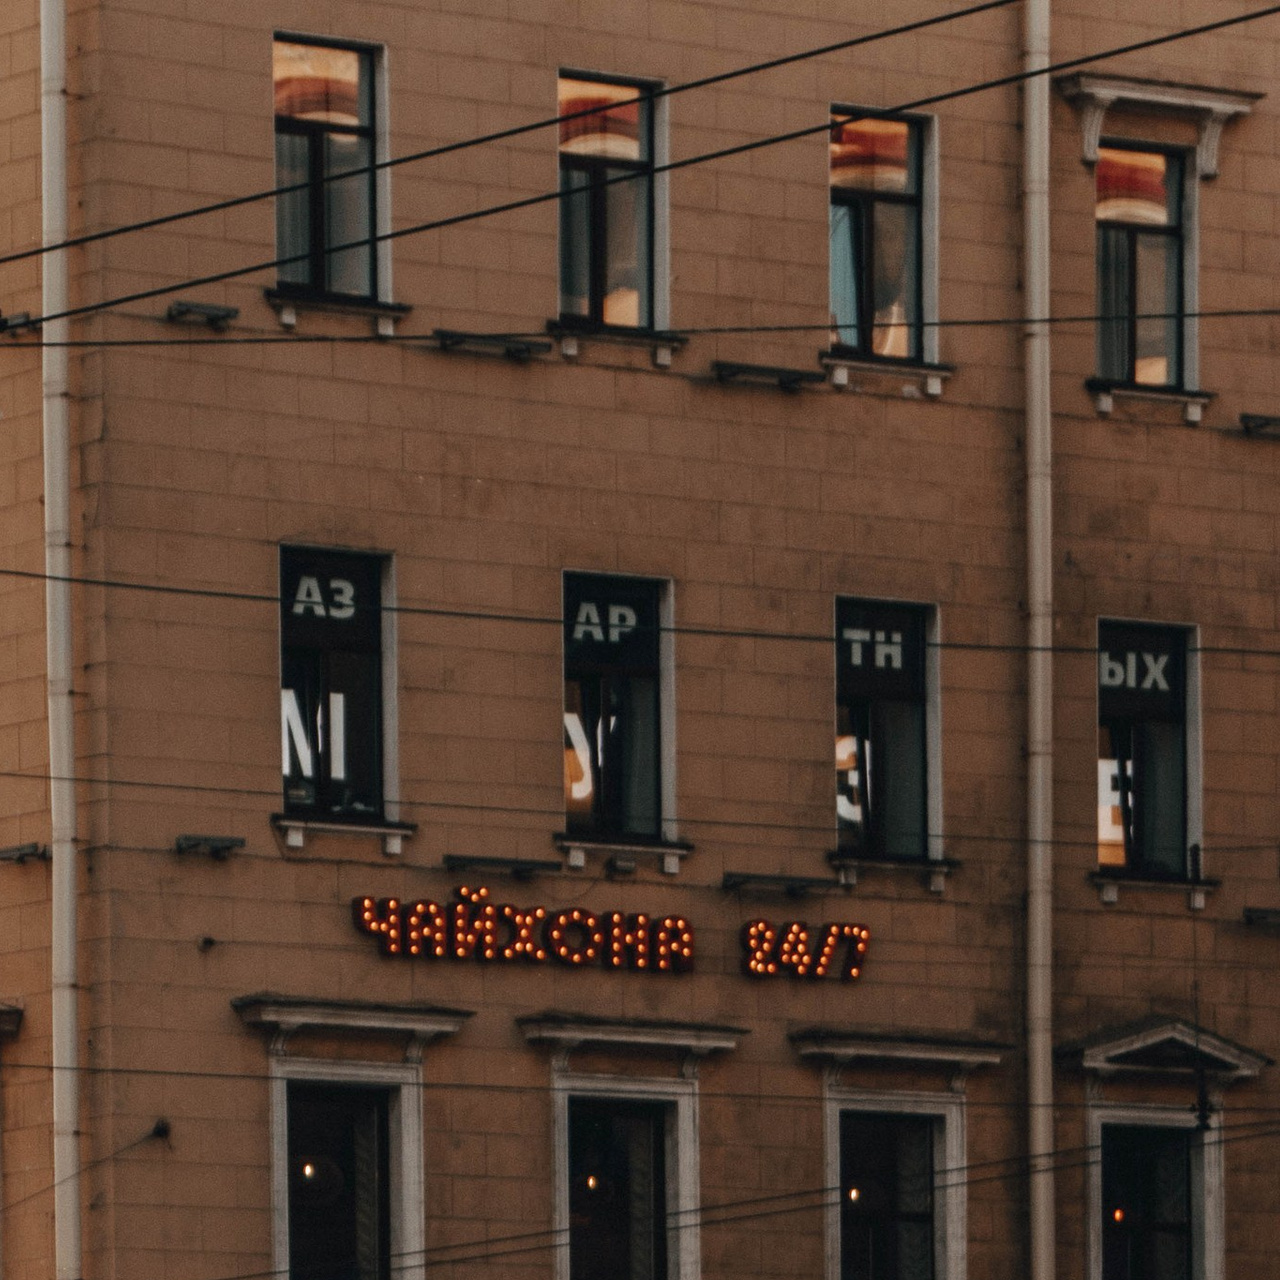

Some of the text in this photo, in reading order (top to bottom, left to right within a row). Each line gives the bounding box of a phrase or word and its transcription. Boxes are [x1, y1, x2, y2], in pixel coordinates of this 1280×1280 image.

[292, 576, 356, 619] АЗ
[572, 602, 637, 643] АР
[1099, 651, 1170, 692] ЫХ
[353, 884, 870, 980] ЧАЙХОНА 24/7
